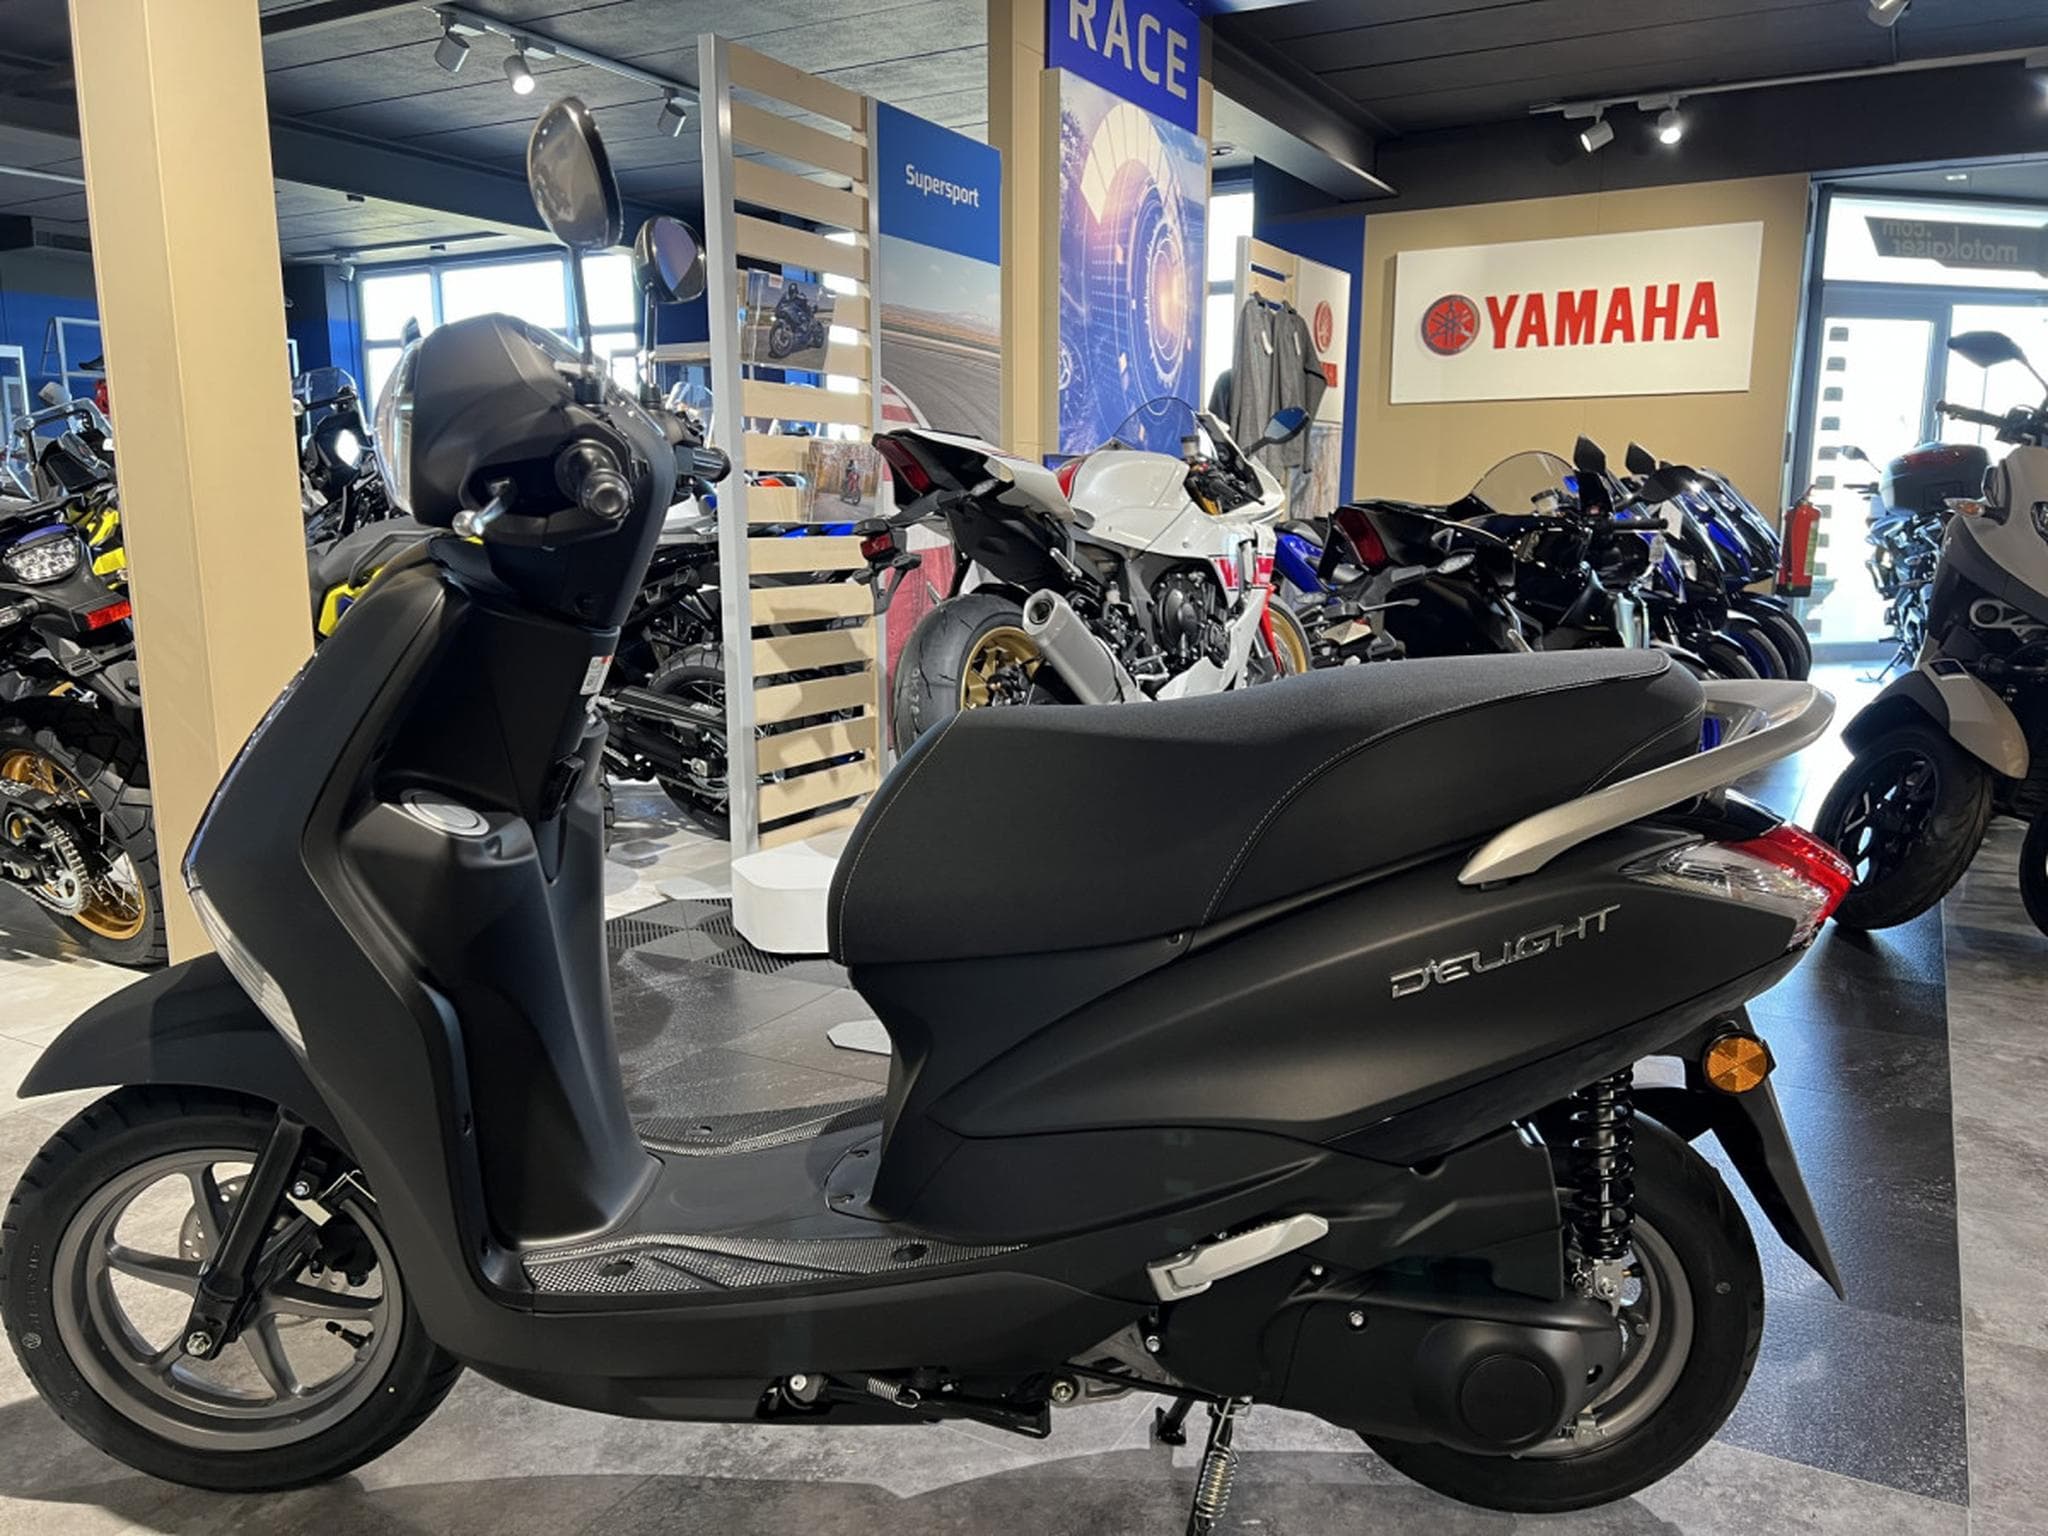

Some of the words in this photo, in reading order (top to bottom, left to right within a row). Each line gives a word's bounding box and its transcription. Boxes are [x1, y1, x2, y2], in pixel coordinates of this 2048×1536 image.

[1069, 0, 1188, 100] RACE
[904, 163, 979, 208] Supersport
[1485, 280, 1719, 349] YAMAHA
